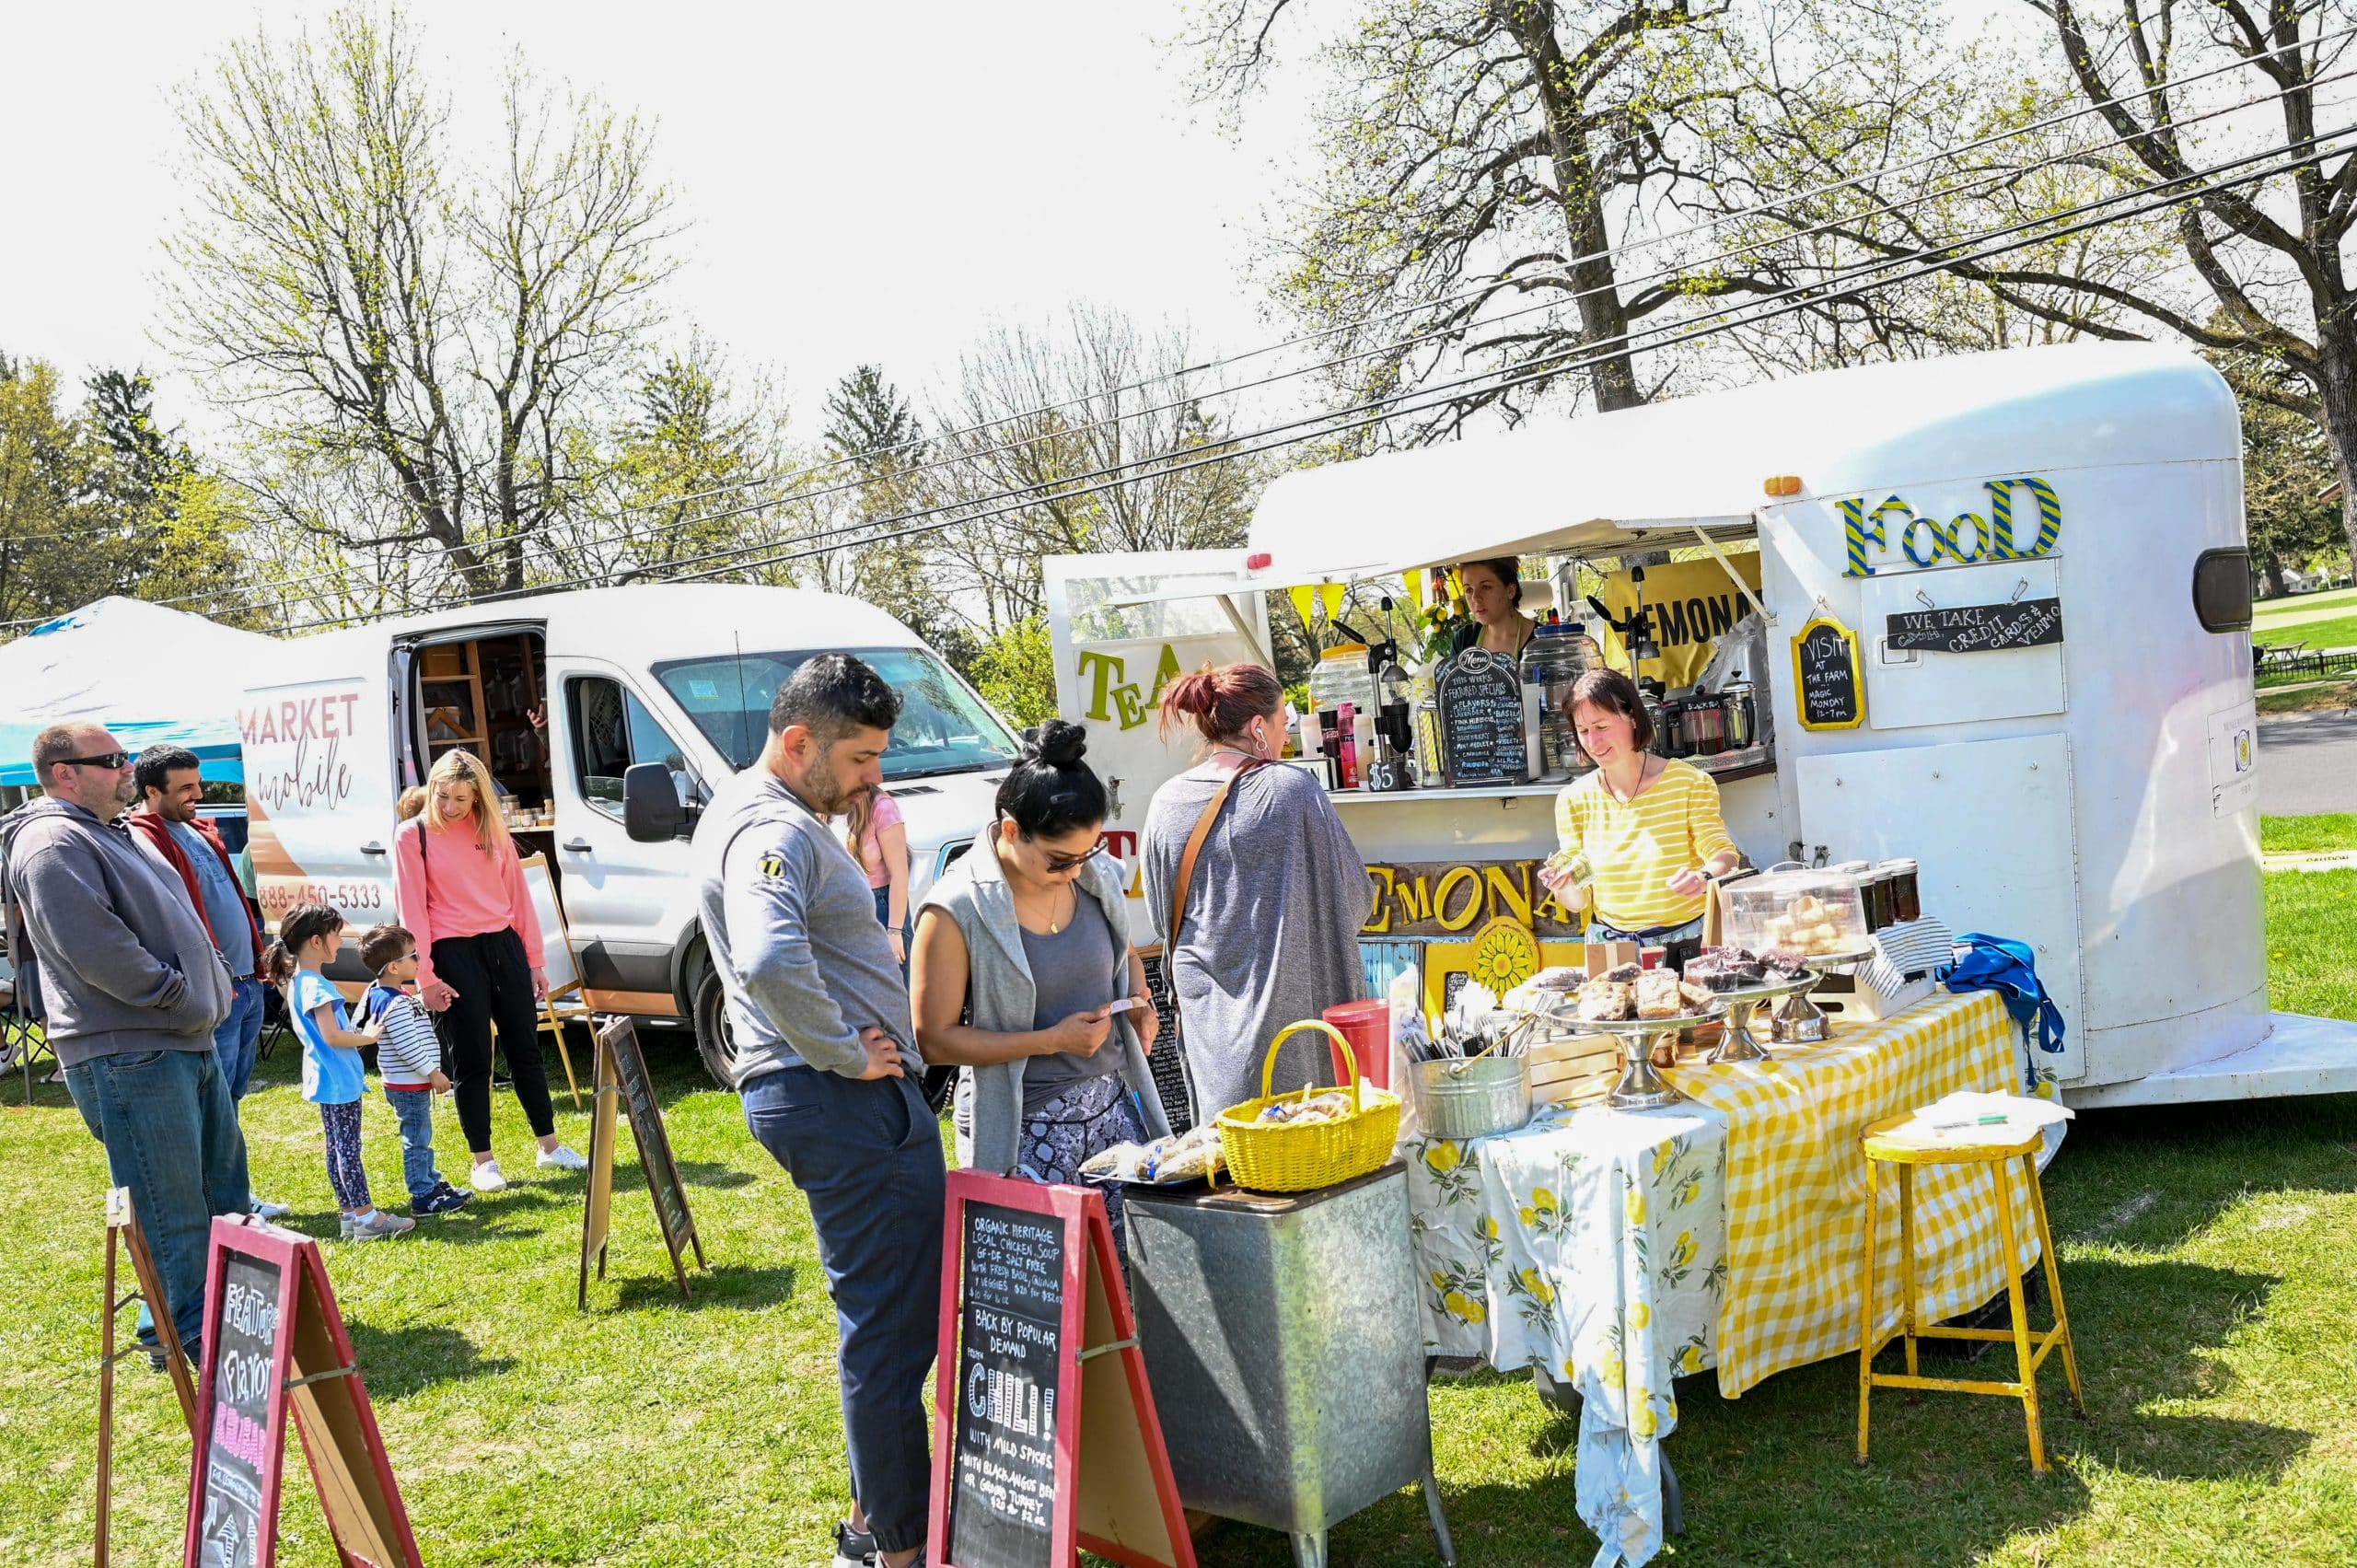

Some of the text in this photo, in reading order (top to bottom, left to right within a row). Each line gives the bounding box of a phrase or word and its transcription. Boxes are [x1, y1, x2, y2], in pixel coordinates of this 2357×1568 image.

[1903, 608, 1986, 630] WE TAKE
[1991, 612, 2033, 648] CARDS
[2017, 606, 2061, 645] VENMO
[1949, 615, 2005, 653] CREDIT
[1462, 652, 1489, 668] Menu
[1806, 636, 1845, 661] VISIT
[1806, 670, 1848, 685] THE FARM
[1816, 660, 1826, 670] AT
[1078, 643, 1181, 730] TEA
[1448, 685, 1478, 700] FEATURED
[1452, 677, 1467, 685] THIS
[1809, 689, 1831, 700] MAGIC
[1810, 697, 1845, 708] MONDAY
[238, 693, 358, 745] MARKET
[259, 727, 352, 811] mobile
[1369, 763, 1393, 790] $5
[972, 1231, 1060, 1260] LOCAL CHICKEN SOUP
[1013, 1224, 1054, 1244] HERITAGE
[971, 1260, 986, 1273] WITH
[990, 1264, 1009, 1278] FRESH
[1032, 1275, 1059, 1291] QUINOA
[1006, 1253, 1023, 1267] SALT
[1027, 1259, 1047, 1274] FREE
[981, 1277, 1008, 1291] VEGGIES
[976, 1309, 1056, 1353] BACK BY POPULAR
[991, 1336, 1027, 1358] DEMAND
[224, 1350, 274, 1403] Flavor
[970, 1427, 1053, 1469] WITH MILD SPICES
[983, 1460, 1008, 1481] BLACK
[1007, 1471, 1037, 1492] ANGUS
[965, 1473, 975, 1488] OR
[1009, 1490, 1043, 1516] TURKEY
